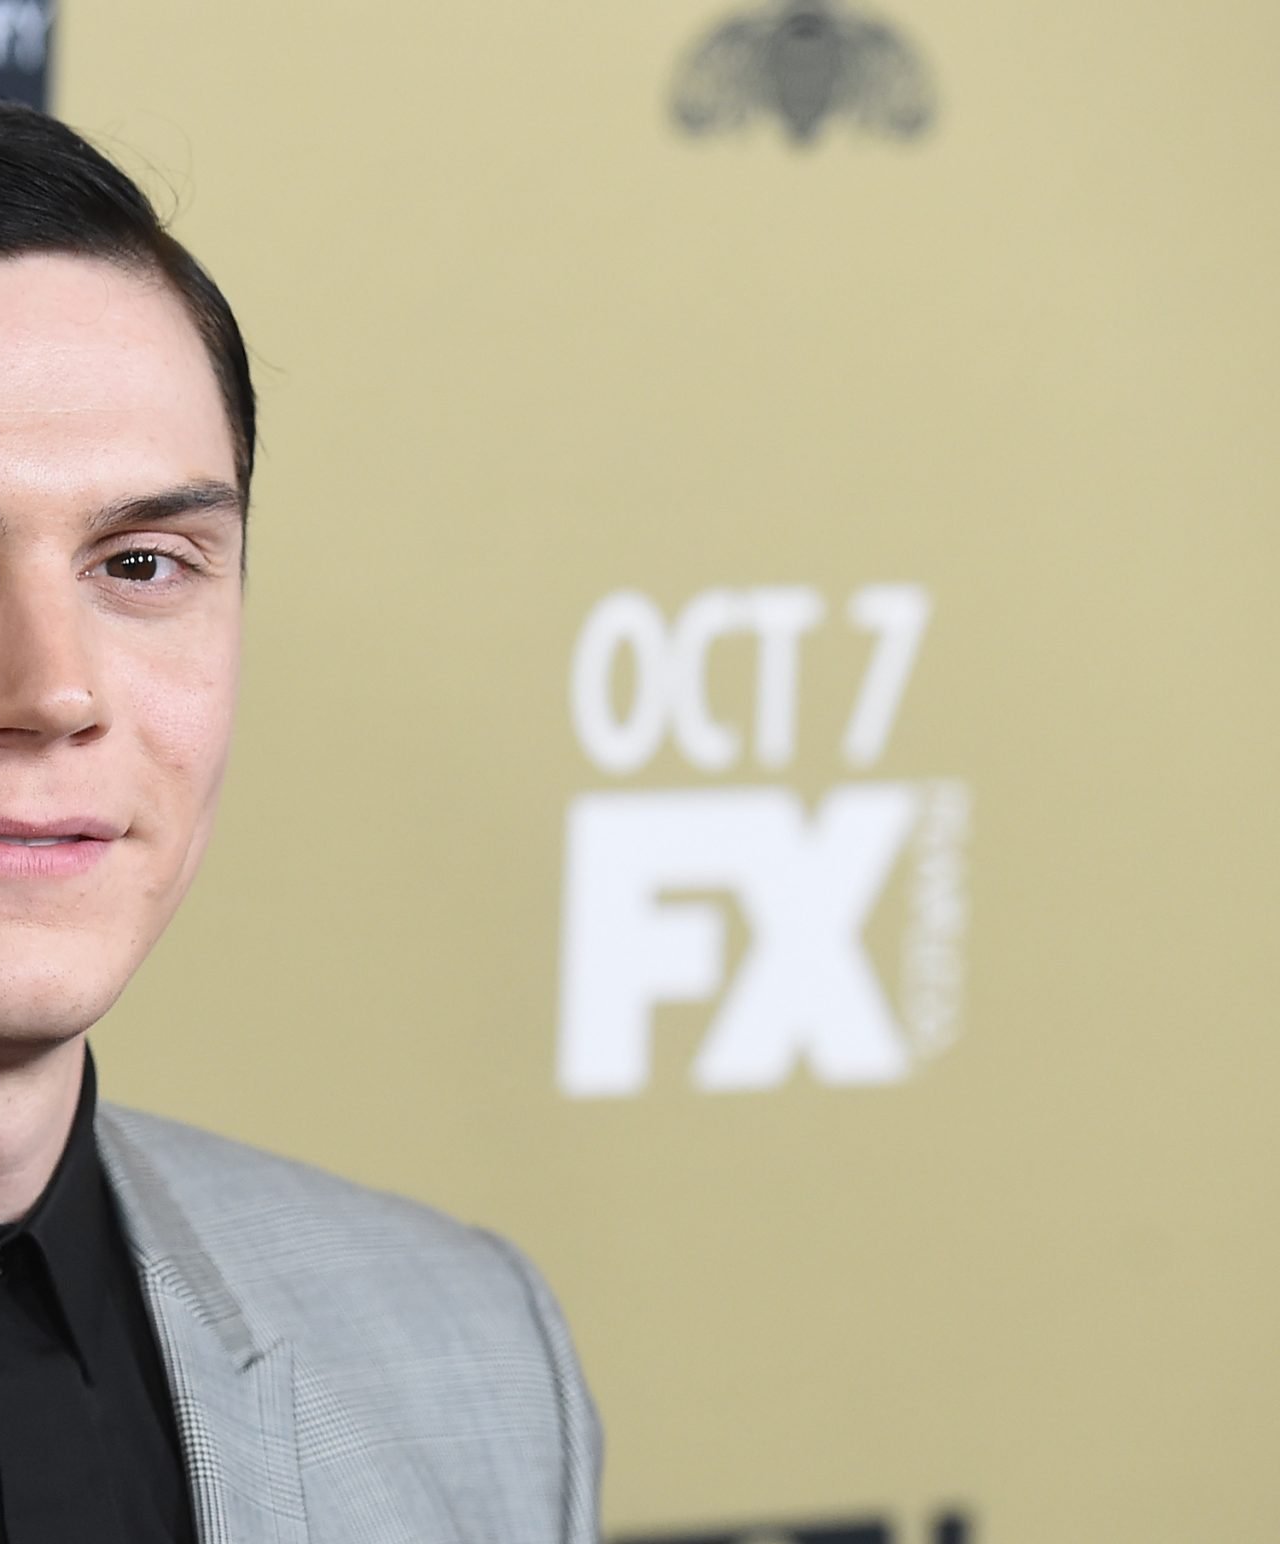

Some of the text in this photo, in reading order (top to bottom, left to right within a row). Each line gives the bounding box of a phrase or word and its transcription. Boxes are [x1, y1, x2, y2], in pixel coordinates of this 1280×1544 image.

[570, 580, 931, 774] OCT 7
[557, 781, 924, 1097] FX
